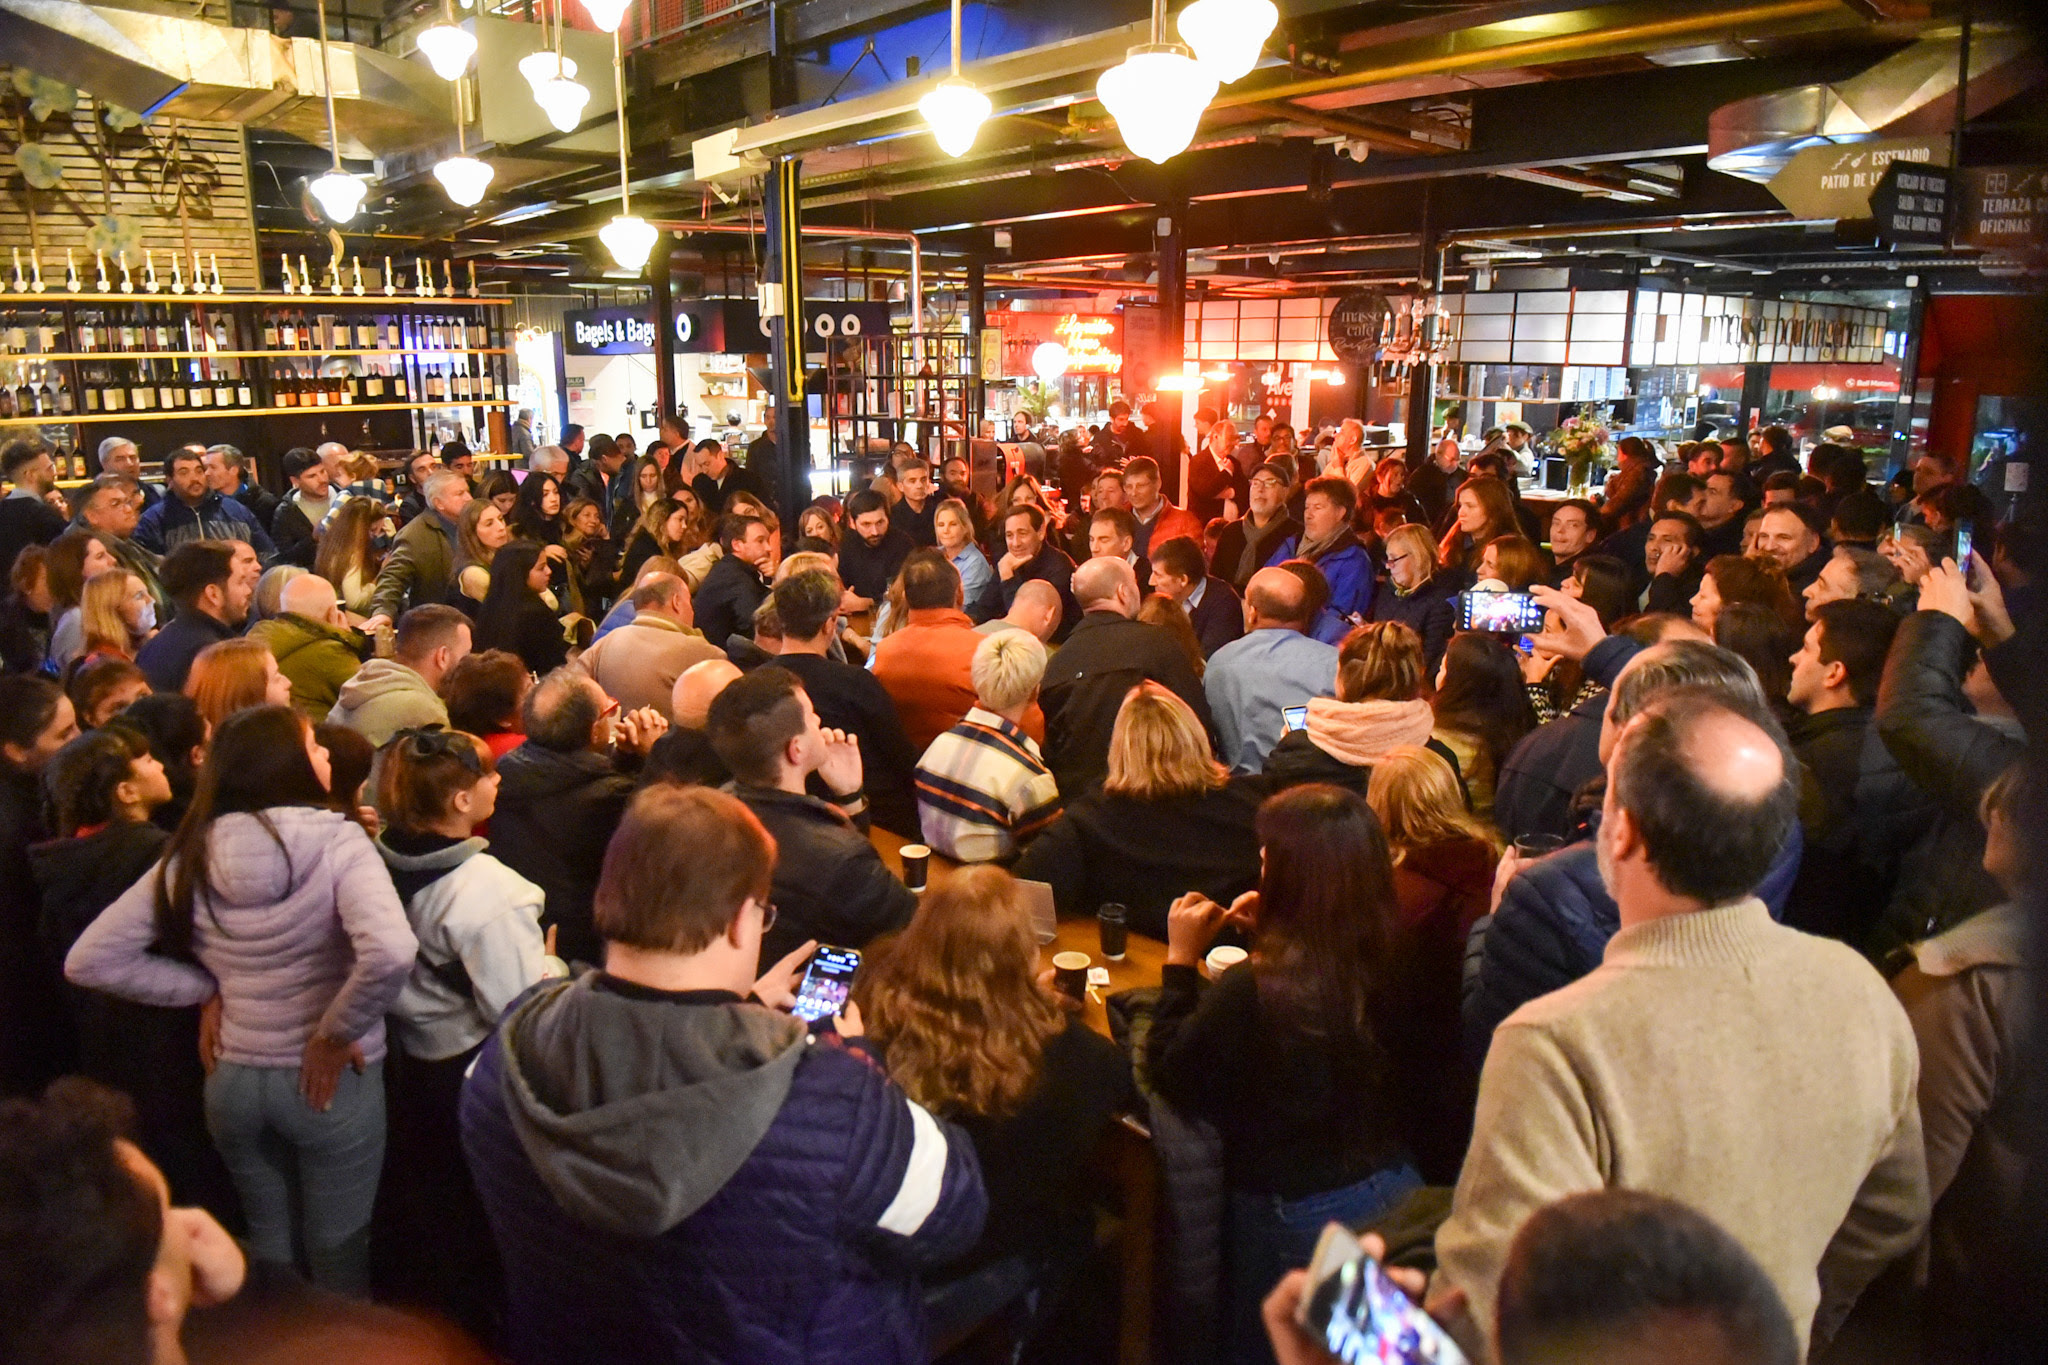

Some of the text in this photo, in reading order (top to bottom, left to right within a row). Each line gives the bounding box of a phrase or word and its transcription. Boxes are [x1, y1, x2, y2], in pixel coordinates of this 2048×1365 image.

[1821, 174, 1850, 190] PATIO
[1853, 172, 1867, 187] DE
[1982, 197, 2031, 214] TERRAZA
[1979, 218, 2031, 234] OFICINAS
[1342, 311, 1383, 323] masse
[575, 319, 615, 349] Bagels
[615, 320, 625, 342] &
